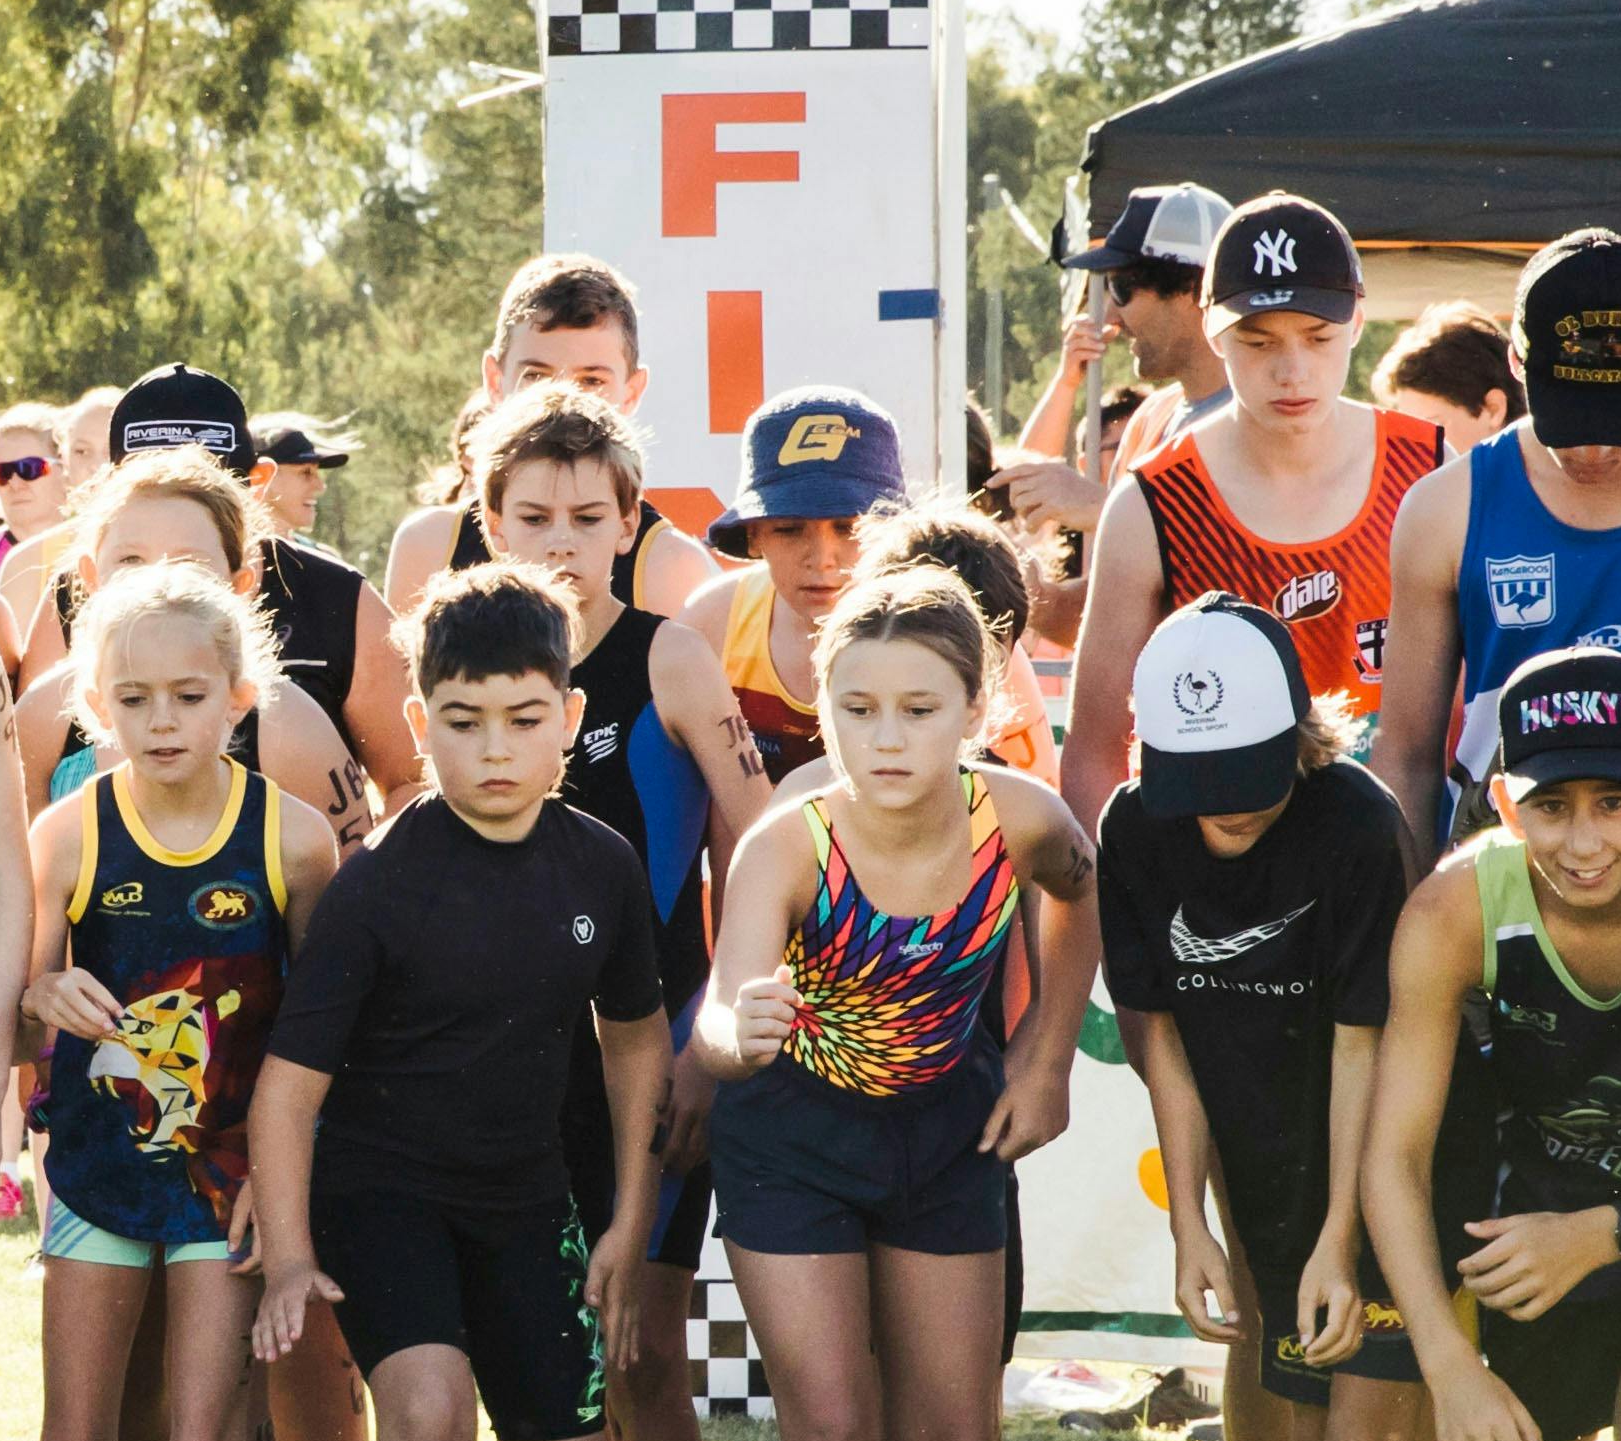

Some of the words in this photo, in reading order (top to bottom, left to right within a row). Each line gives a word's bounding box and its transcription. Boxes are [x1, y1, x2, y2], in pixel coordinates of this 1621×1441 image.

[1252, 228, 1298, 276] NY
[127, 426, 193, 440] RIVERINA
[1491, 565, 1549, 577] KANGAROOS
[1282, 570, 1337, 620] dare
[1520, 690, 1619, 735] HUSKY
[582, 721, 619, 746] EPIC
[898, 941, 944, 955] speedo
[1176, 973, 1314, 996] COLLINGWO
